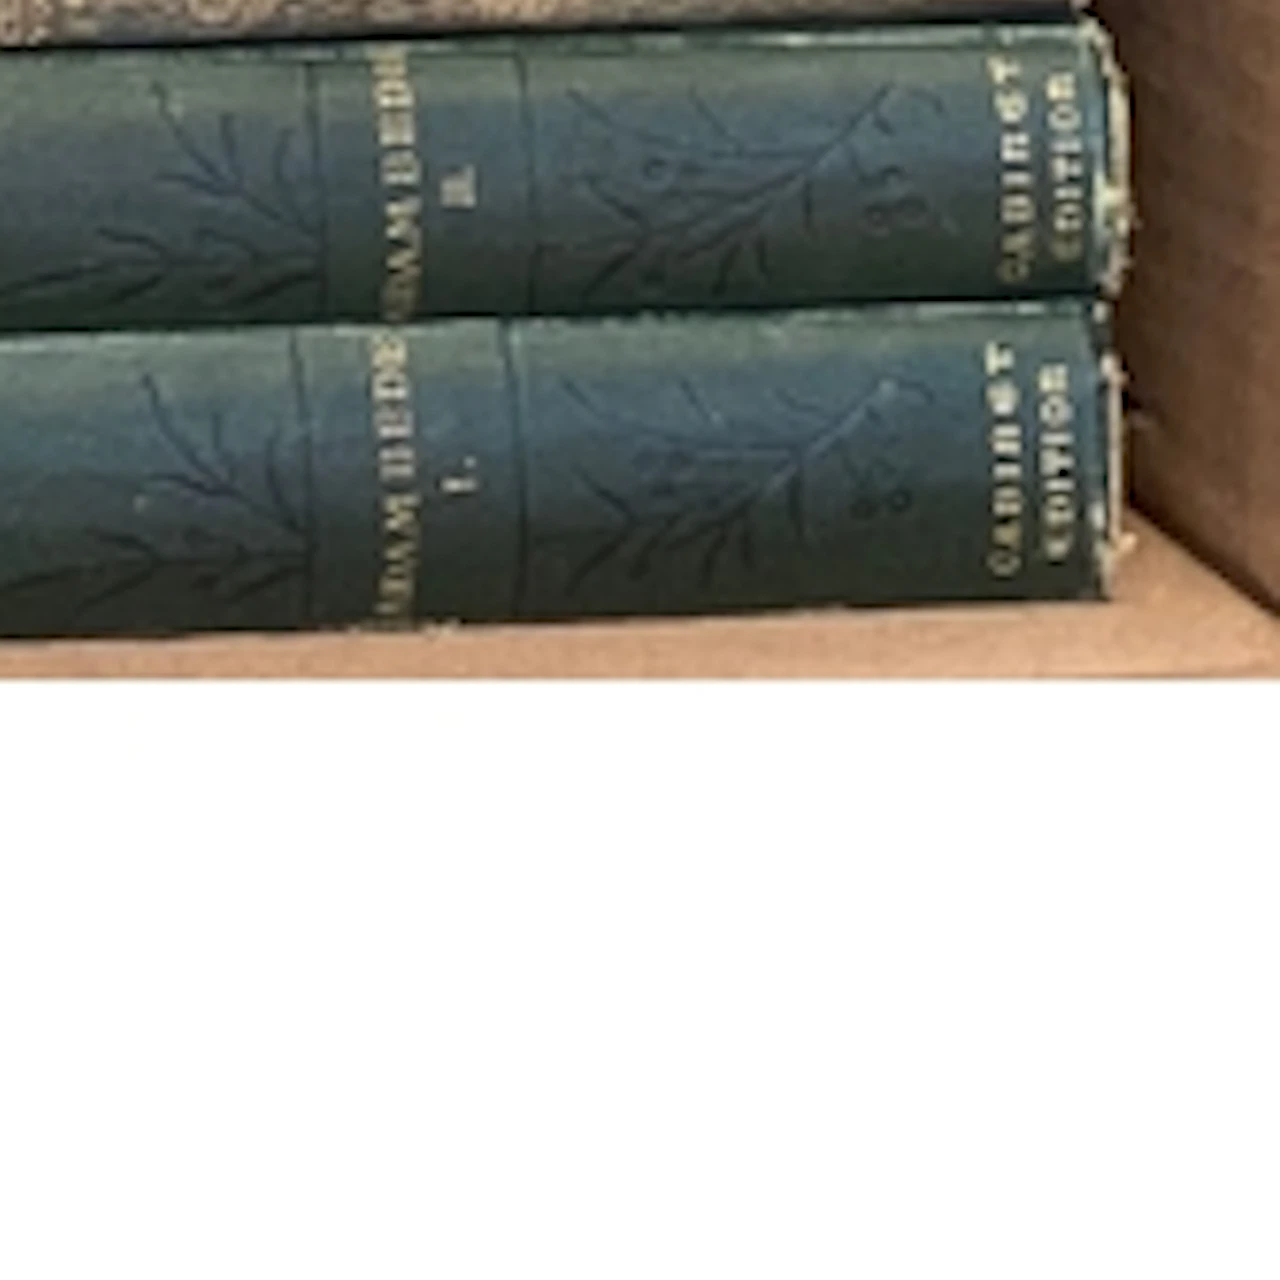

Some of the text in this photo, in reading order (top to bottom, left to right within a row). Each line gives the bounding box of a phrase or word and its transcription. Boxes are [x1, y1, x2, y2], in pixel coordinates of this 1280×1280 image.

[983, 52, 1032, 284] CABINET
[1044, 70, 1083, 261] EDITION
[983, 338, 1023, 576] CABINET
[1037, 362, 1075, 562] EDITION
